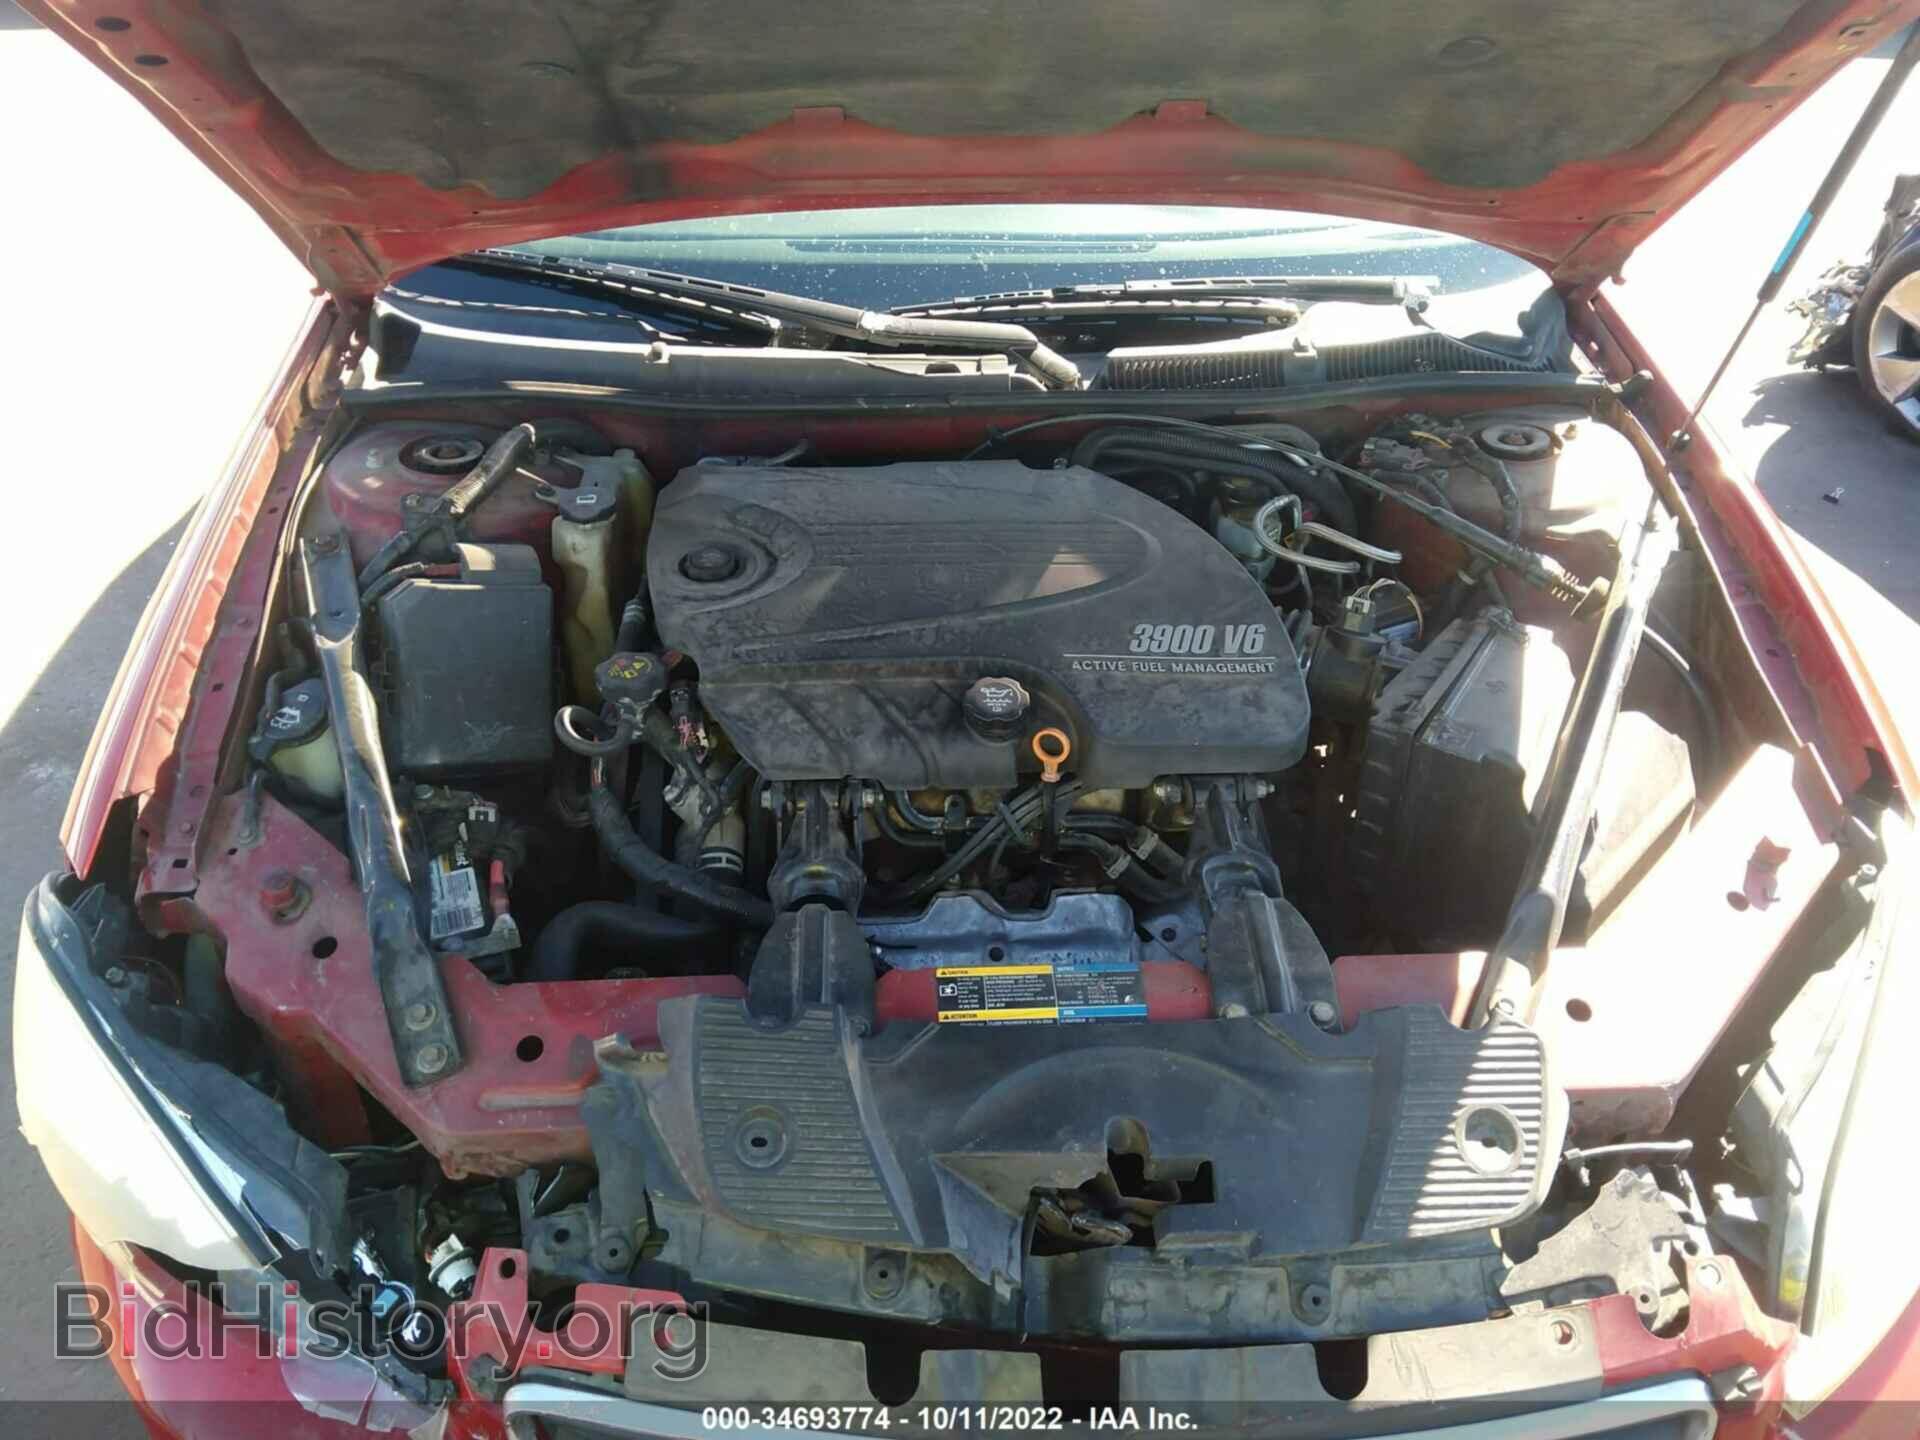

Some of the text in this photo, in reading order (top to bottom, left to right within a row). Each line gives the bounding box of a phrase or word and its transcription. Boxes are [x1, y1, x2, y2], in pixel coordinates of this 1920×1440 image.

[1129, 623, 1266, 654] 3900 V6
[1072, 660, 1275, 674] ACTIVE FUEL MANAGEMENT
